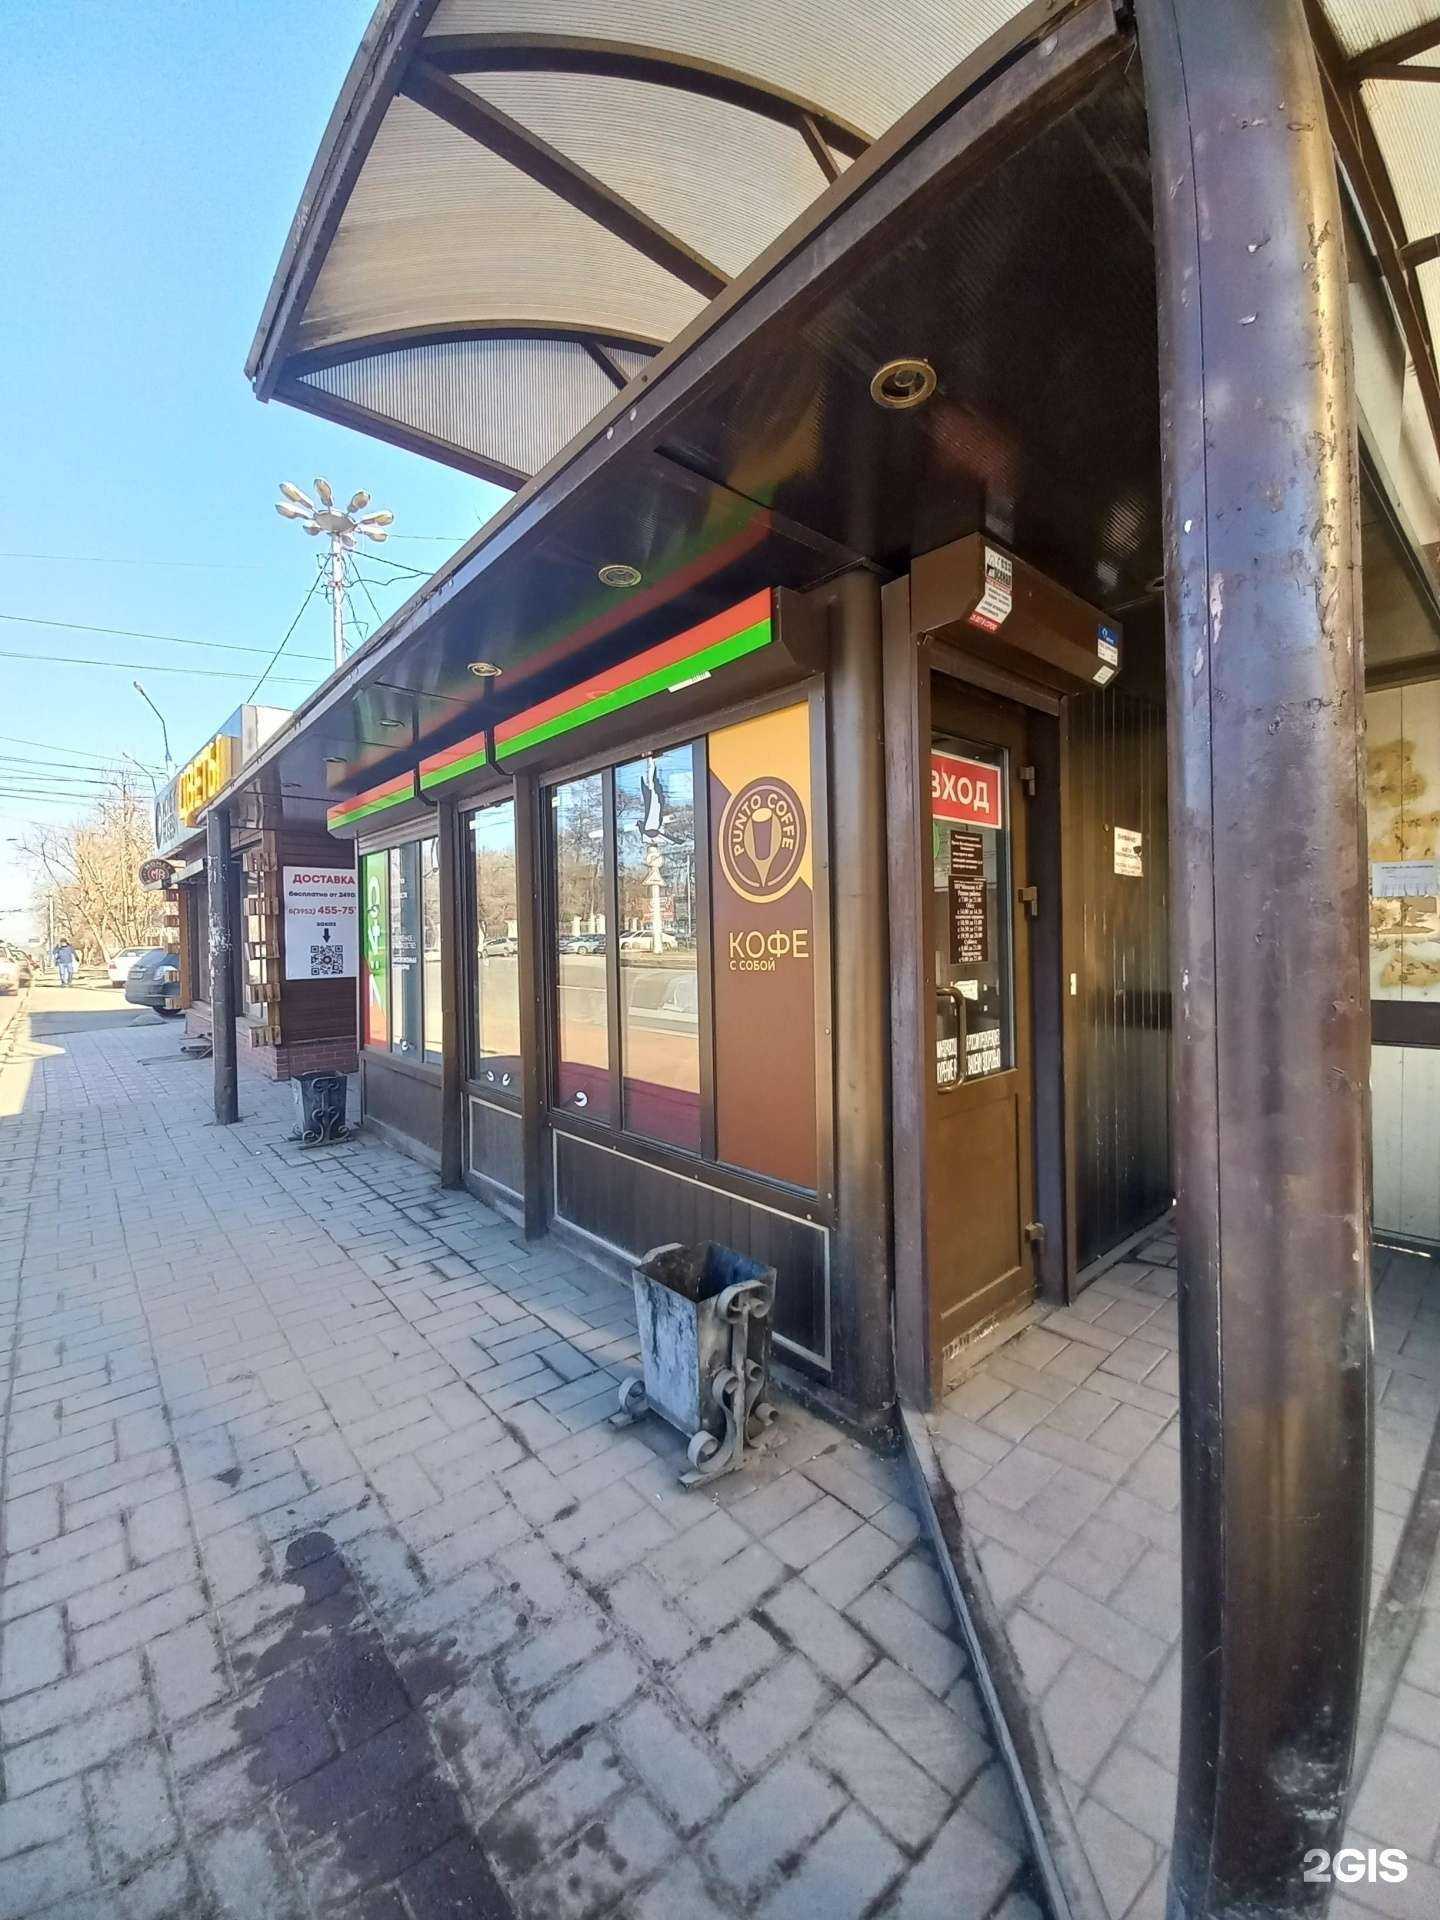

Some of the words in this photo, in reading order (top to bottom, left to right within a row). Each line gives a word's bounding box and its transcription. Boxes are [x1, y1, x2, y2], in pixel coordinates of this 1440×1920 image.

[931, 769, 989, 814] ВХОД
[732, 794, 762, 857] PUNTO
[767, 792, 794, 850] COFFE
[293, 874, 356, 885] ДОСТАВКА
[288, 890, 328, 898] бесплатно
[317, 905, 357, 915] 455-75
[729, 929, 809, 959] КОФЕ
